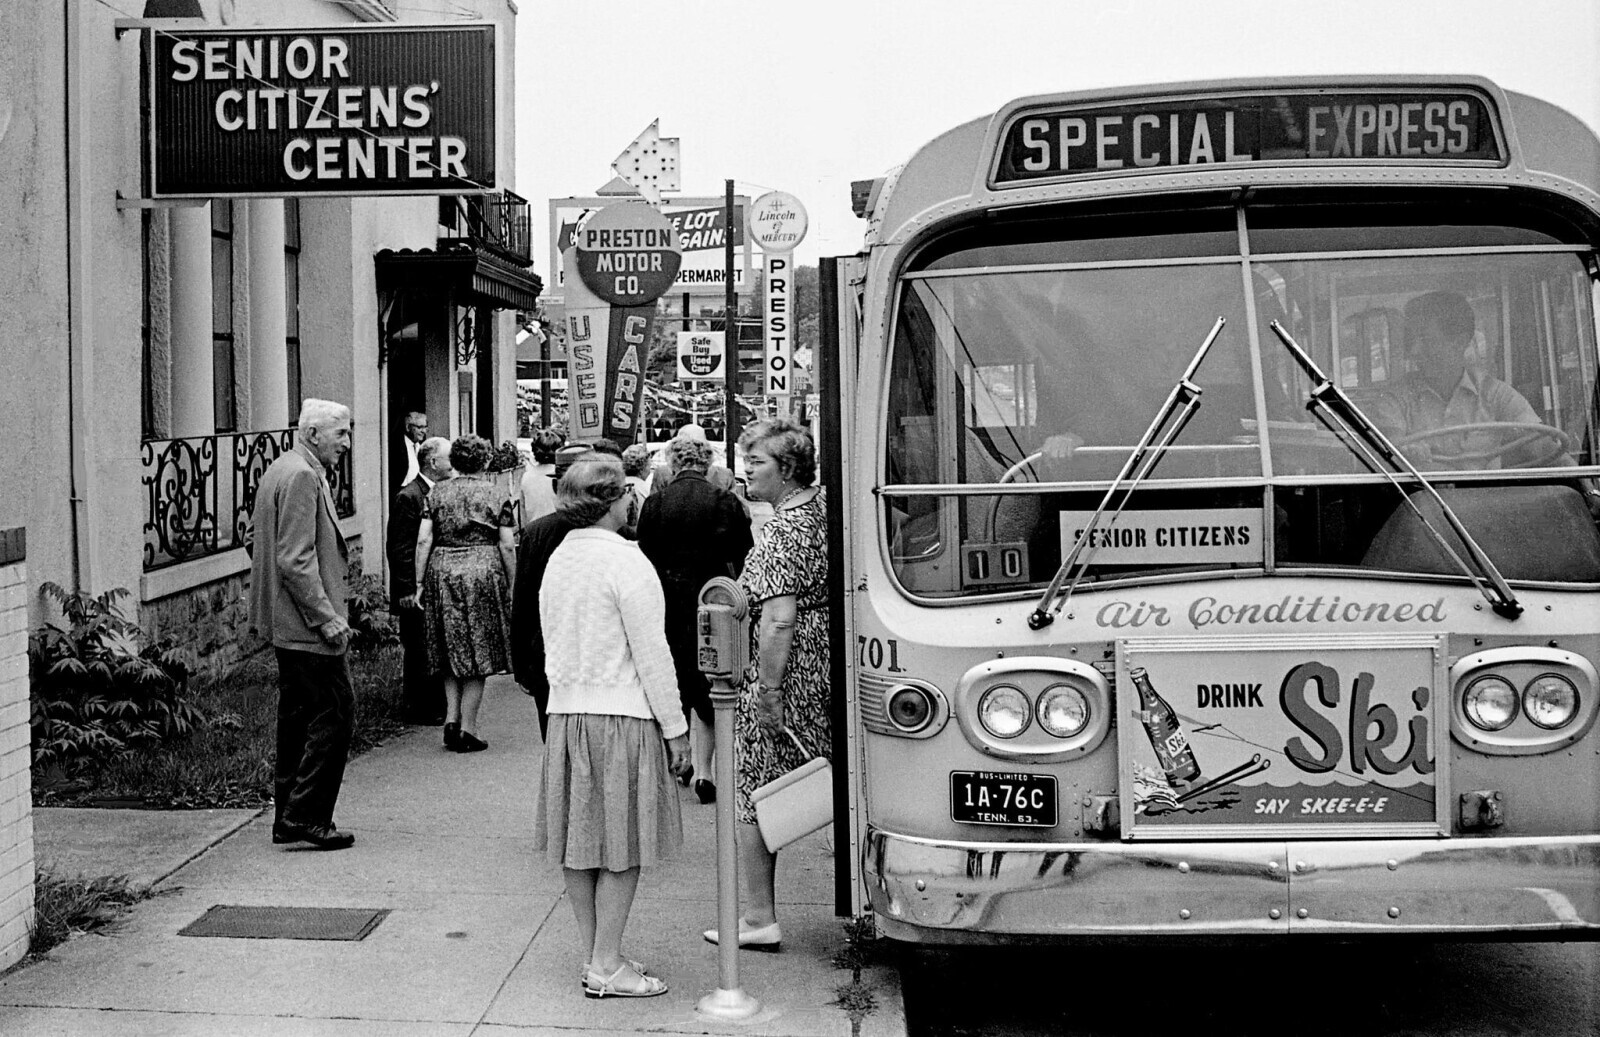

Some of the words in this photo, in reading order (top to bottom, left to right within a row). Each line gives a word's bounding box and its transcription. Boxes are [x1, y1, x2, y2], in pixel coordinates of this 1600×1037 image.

[171, 38, 349, 81] SENIOR
[215, 81, 440, 132] CITIZENS'
[1022, 112, 1252, 172] SPECIAL
[1308, 101, 1469, 159] EXPRESS
[283, 136, 467, 180] CENTER
[683, 211, 720, 230] LOT
[757, 210, 796, 222] Lincoln
[586, 229, 671, 248] PRESTON
[761, 233, 798, 242] MERCURY
[596, 253, 663, 272] MOTOR
[614, 276, 645, 295] CO.
[770, 259, 786, 391] PRESTON
[691, 337, 711, 345] Safe
[692, 345, 710, 355] Buy
[690, 355, 711, 365] Used
[570, 315, 599, 429] USED
[612, 316, 646, 429] CARS
[1074, 528, 1147, 548] SENIOR
[1155, 525, 1250, 547] CITIZENS
[1096, 601, 1170, 629] Air
[1188, 596, 1447, 631] Conditioned
[1197, 684, 1264, 709] DRINK
[1279, 661, 1436, 776] Ski
[1168, 732, 1187, 753] Ski
[1253, 799, 1290, 815] SAY
[1300, 797, 1389, 814] SKEE-E-E
[977, 812, 1010, 823] TENN.
